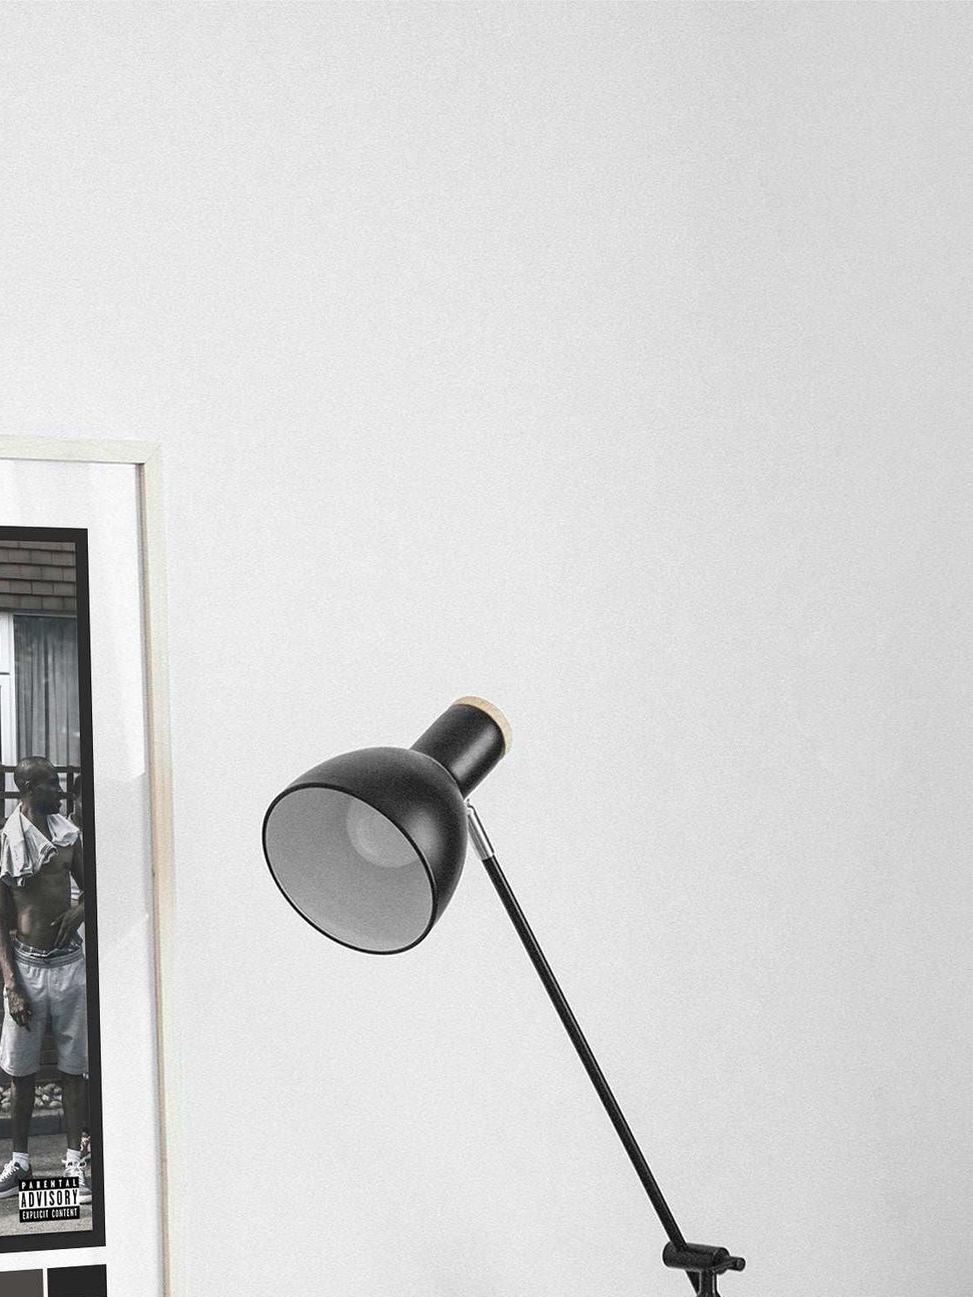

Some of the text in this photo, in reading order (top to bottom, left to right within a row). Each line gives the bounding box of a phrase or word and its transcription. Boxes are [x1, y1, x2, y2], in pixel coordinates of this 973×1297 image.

[21, 1178, 77, 1190] PARENTAL
[21, 1189, 78, 1208] ADVISORY
[22, 1207, 78, 1220] EXPLICIT CONTENT
